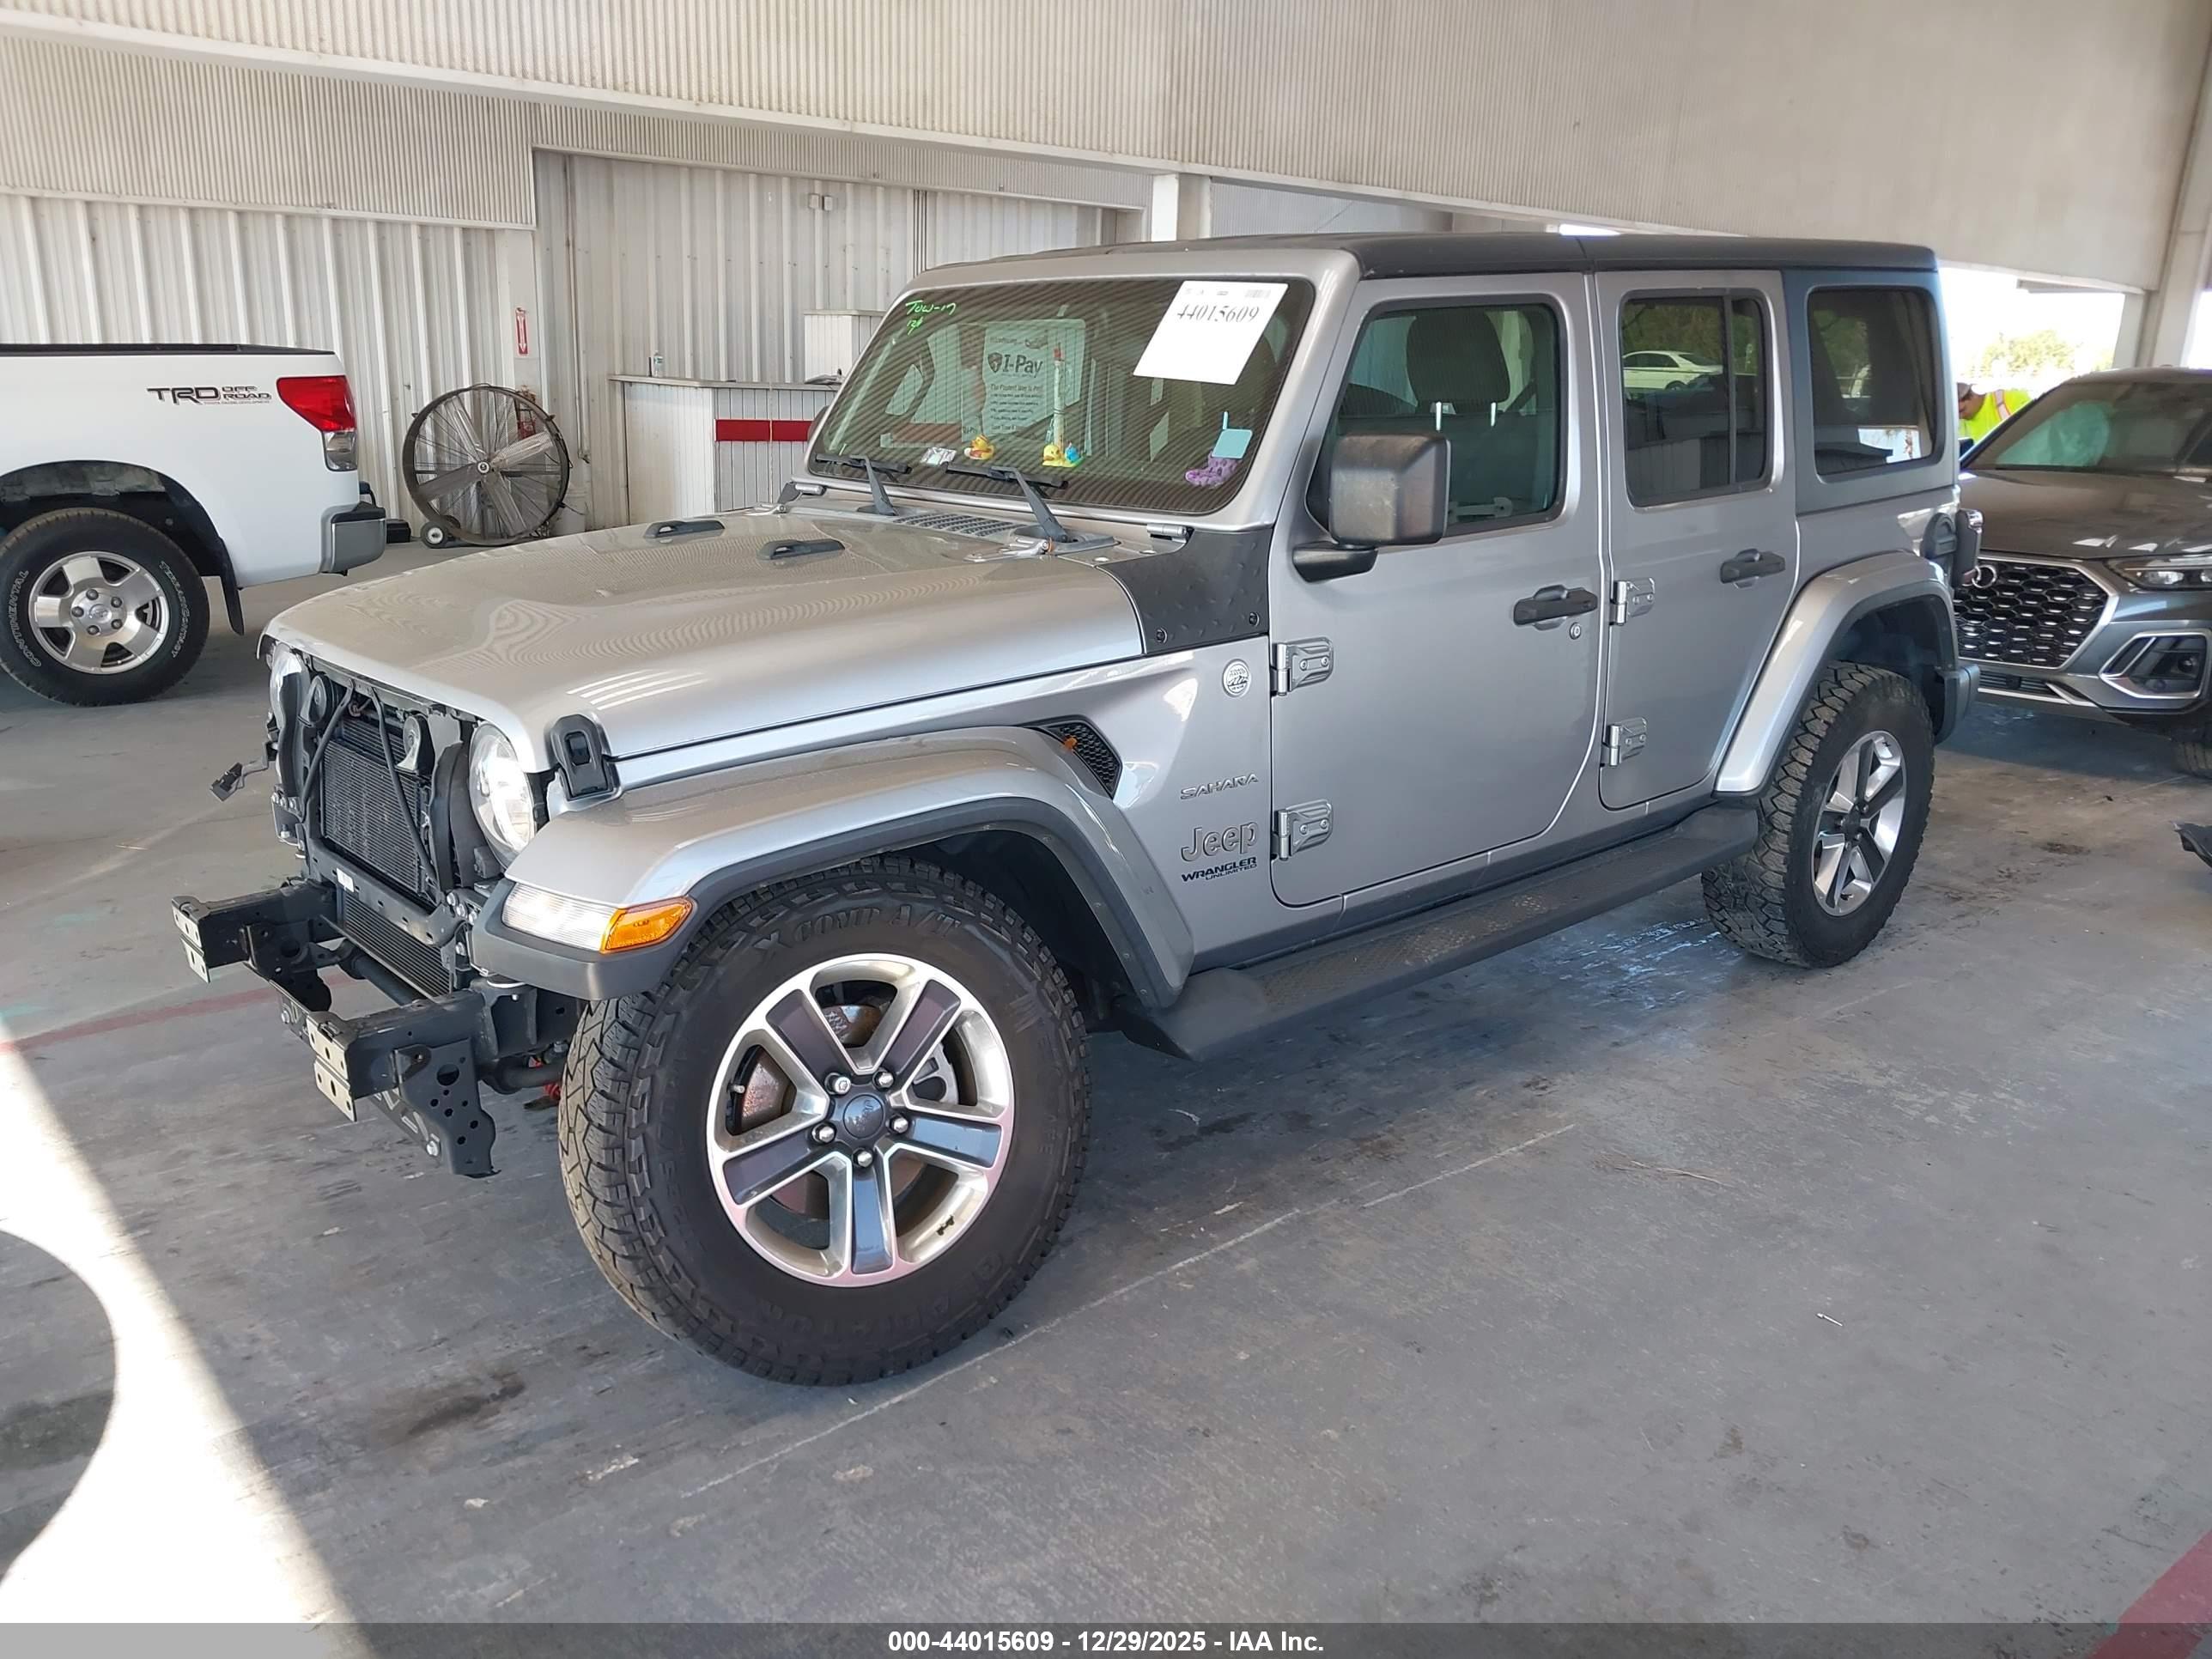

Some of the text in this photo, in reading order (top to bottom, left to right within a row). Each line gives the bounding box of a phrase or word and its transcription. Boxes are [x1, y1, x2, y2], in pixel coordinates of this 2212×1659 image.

[1177, 304, 1260, 322] 44015609
[1002, 354, 1043, 379] I-Pay
[147, 387, 221, 404] TRD
[8, 570, 42, 667] CONTINENTAL
[1180, 773, 1260, 800] SAHARA
[1181, 822, 1259, 862] Jeep
[1181, 856, 1257, 882] WRANGLER
[1205, 863, 1258, 881] UNLIMITED
